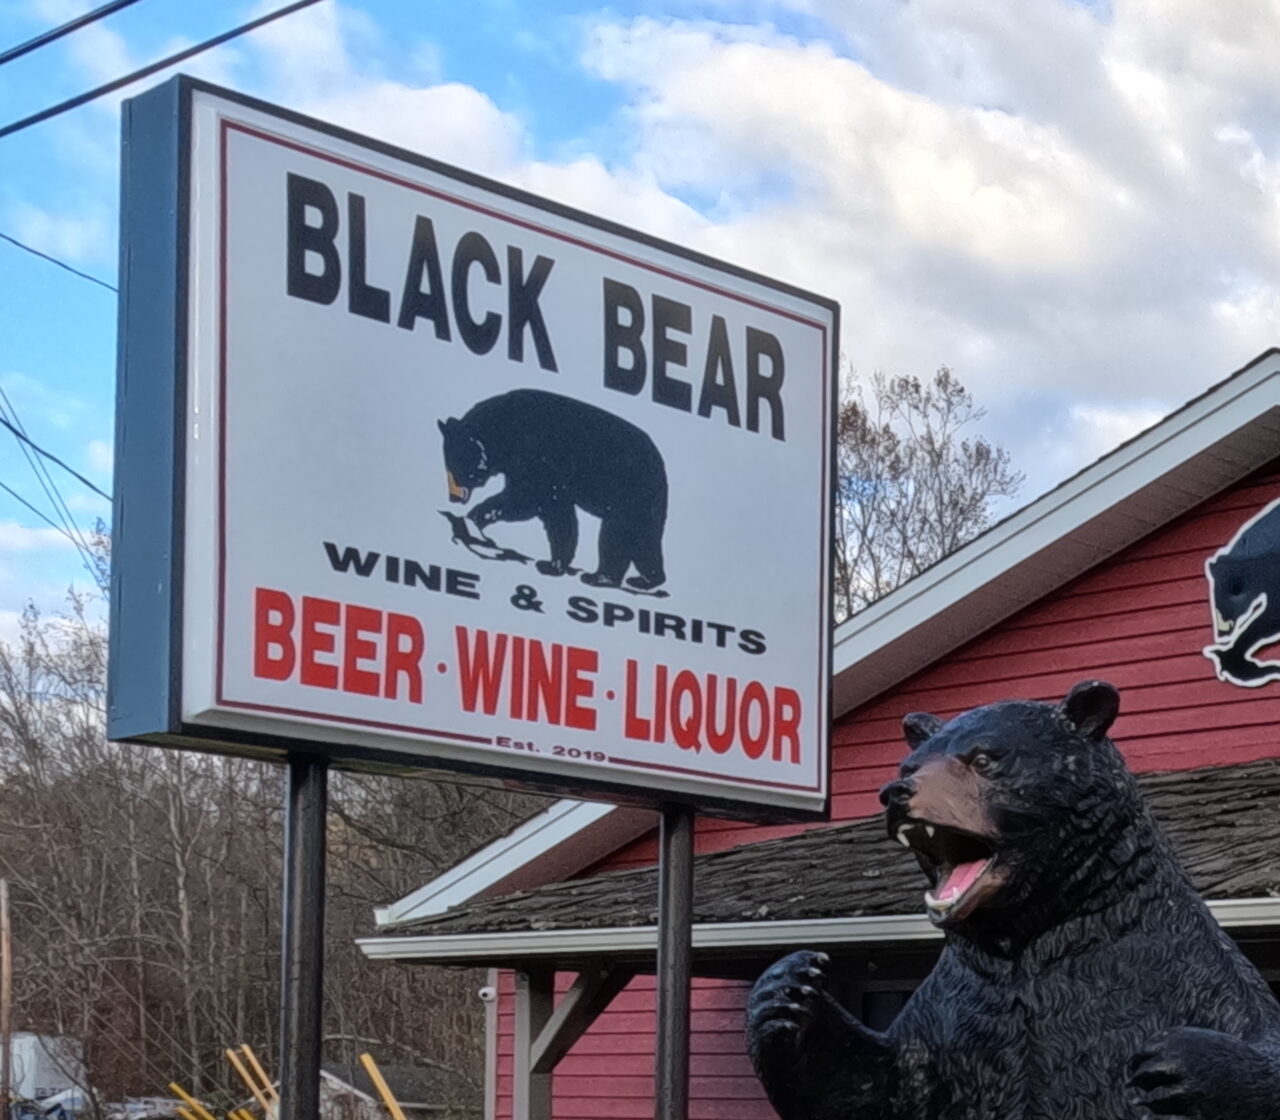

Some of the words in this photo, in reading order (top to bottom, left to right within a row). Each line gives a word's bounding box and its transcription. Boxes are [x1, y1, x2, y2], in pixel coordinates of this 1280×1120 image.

[286, 171, 560, 373] BLACK
[603, 276, 786, 442] BEAR
[322, 541, 481, 600] WINE
[510, 585, 545, 613] &
[567, 595, 767, 655] SPIRITS
[254, 587, 425, 704] BEER
[455, 625, 598, 731] WINE
[625, 658, 802, 765] LIQUOR
[496, 736, 541, 753] Est.
[552, 745, 606, 762] 2019
